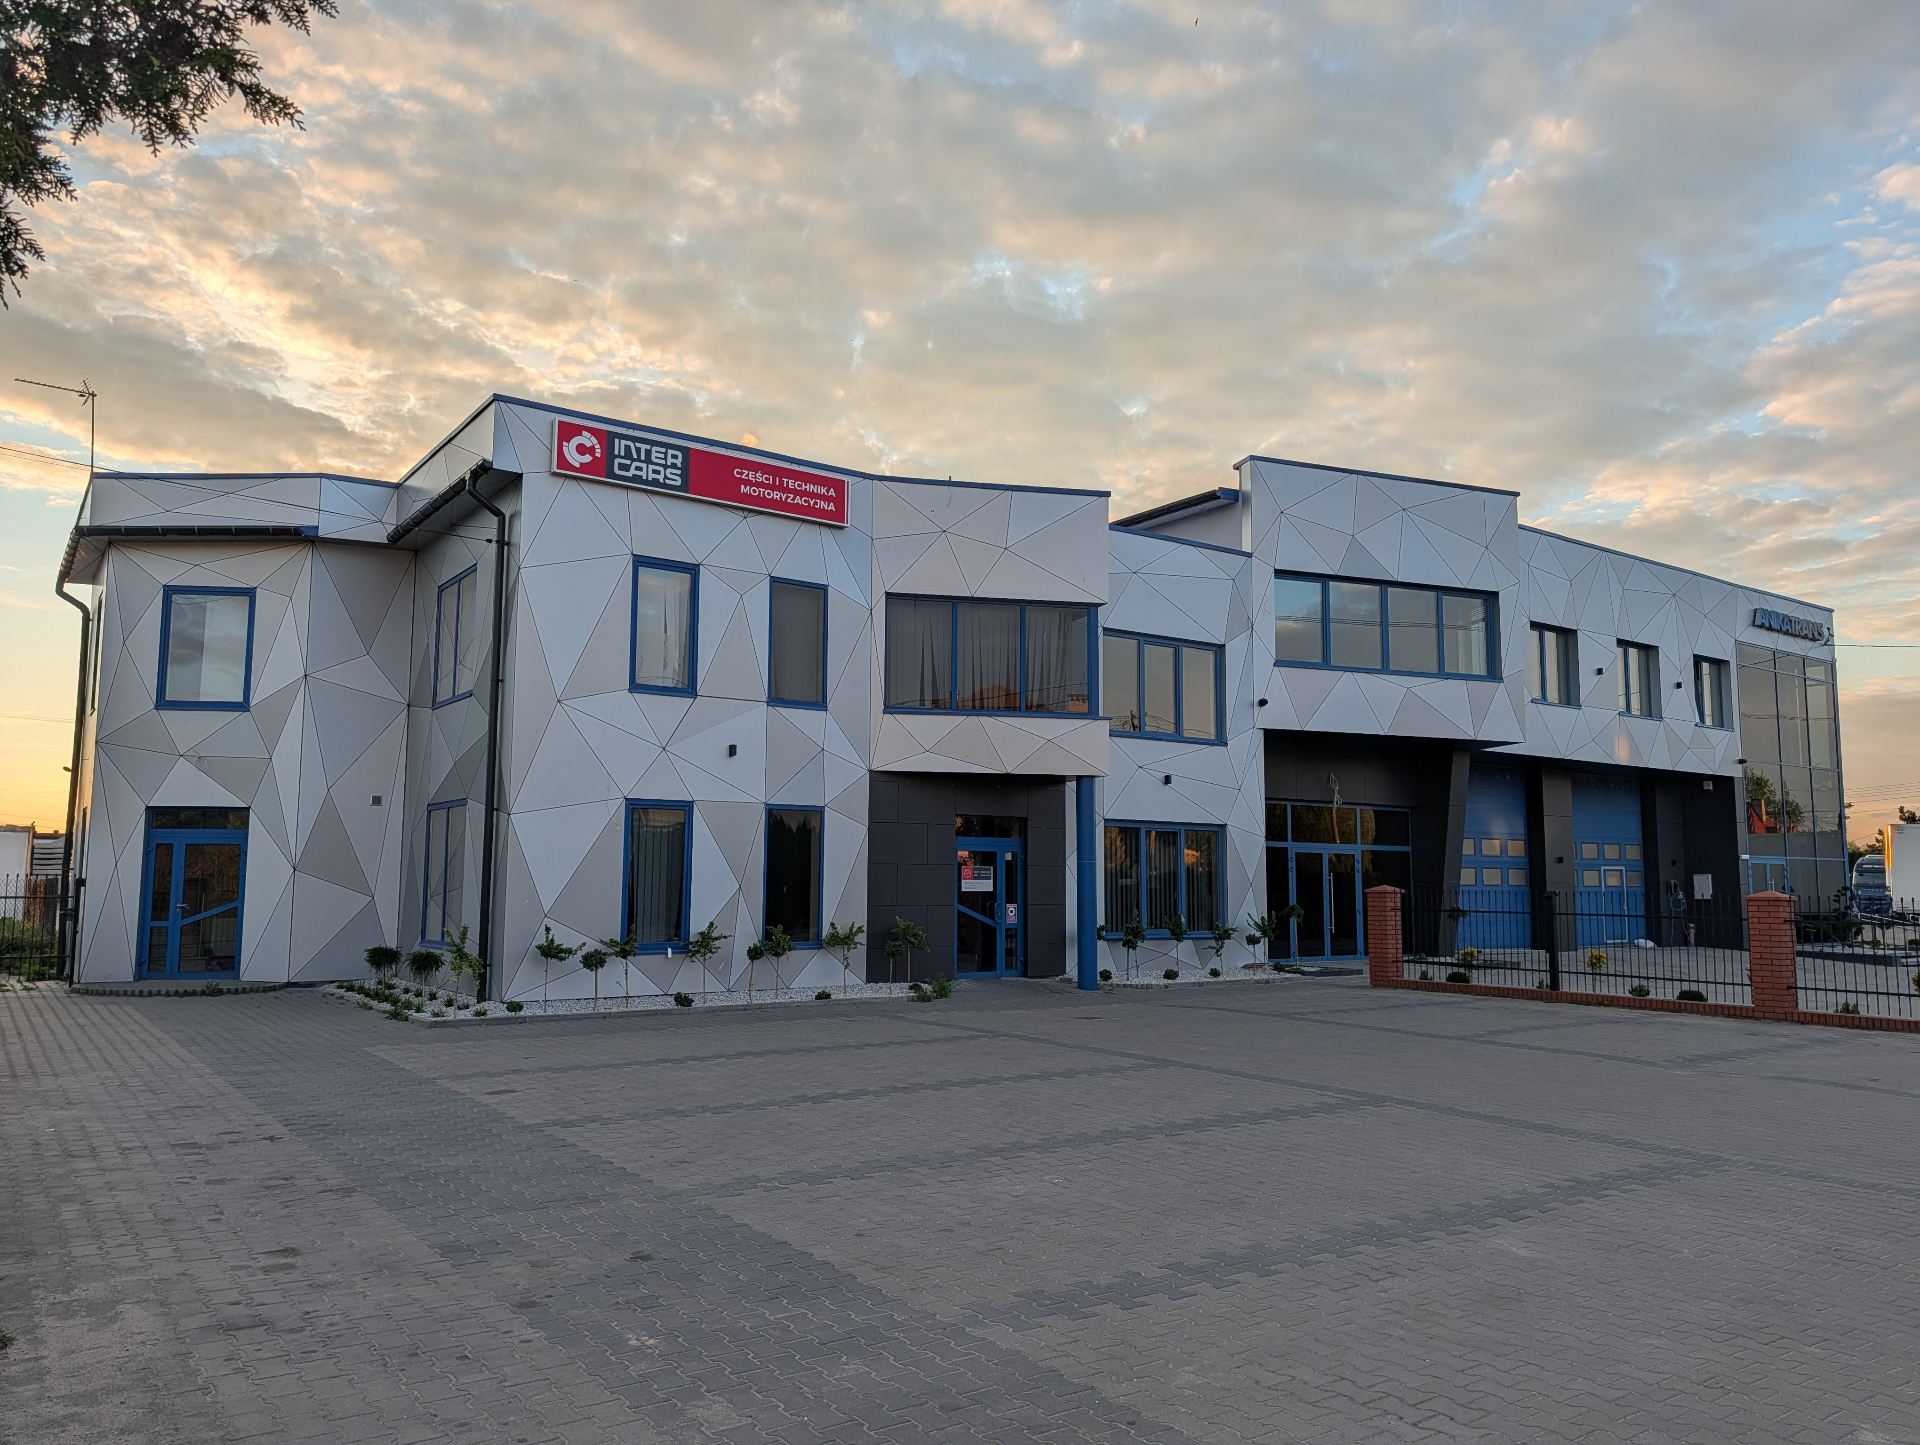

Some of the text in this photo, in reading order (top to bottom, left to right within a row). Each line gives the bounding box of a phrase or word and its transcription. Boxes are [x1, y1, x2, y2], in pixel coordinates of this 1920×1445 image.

[614, 438, 683, 467] INTER
[613, 457, 682, 486] CARS
[733, 468, 836, 497] CZĘŚCI I TECHNIKA
[740, 484, 836, 512] MOTORYZACYJNA
[1757, 607, 1824, 640] ANIKATRANS
